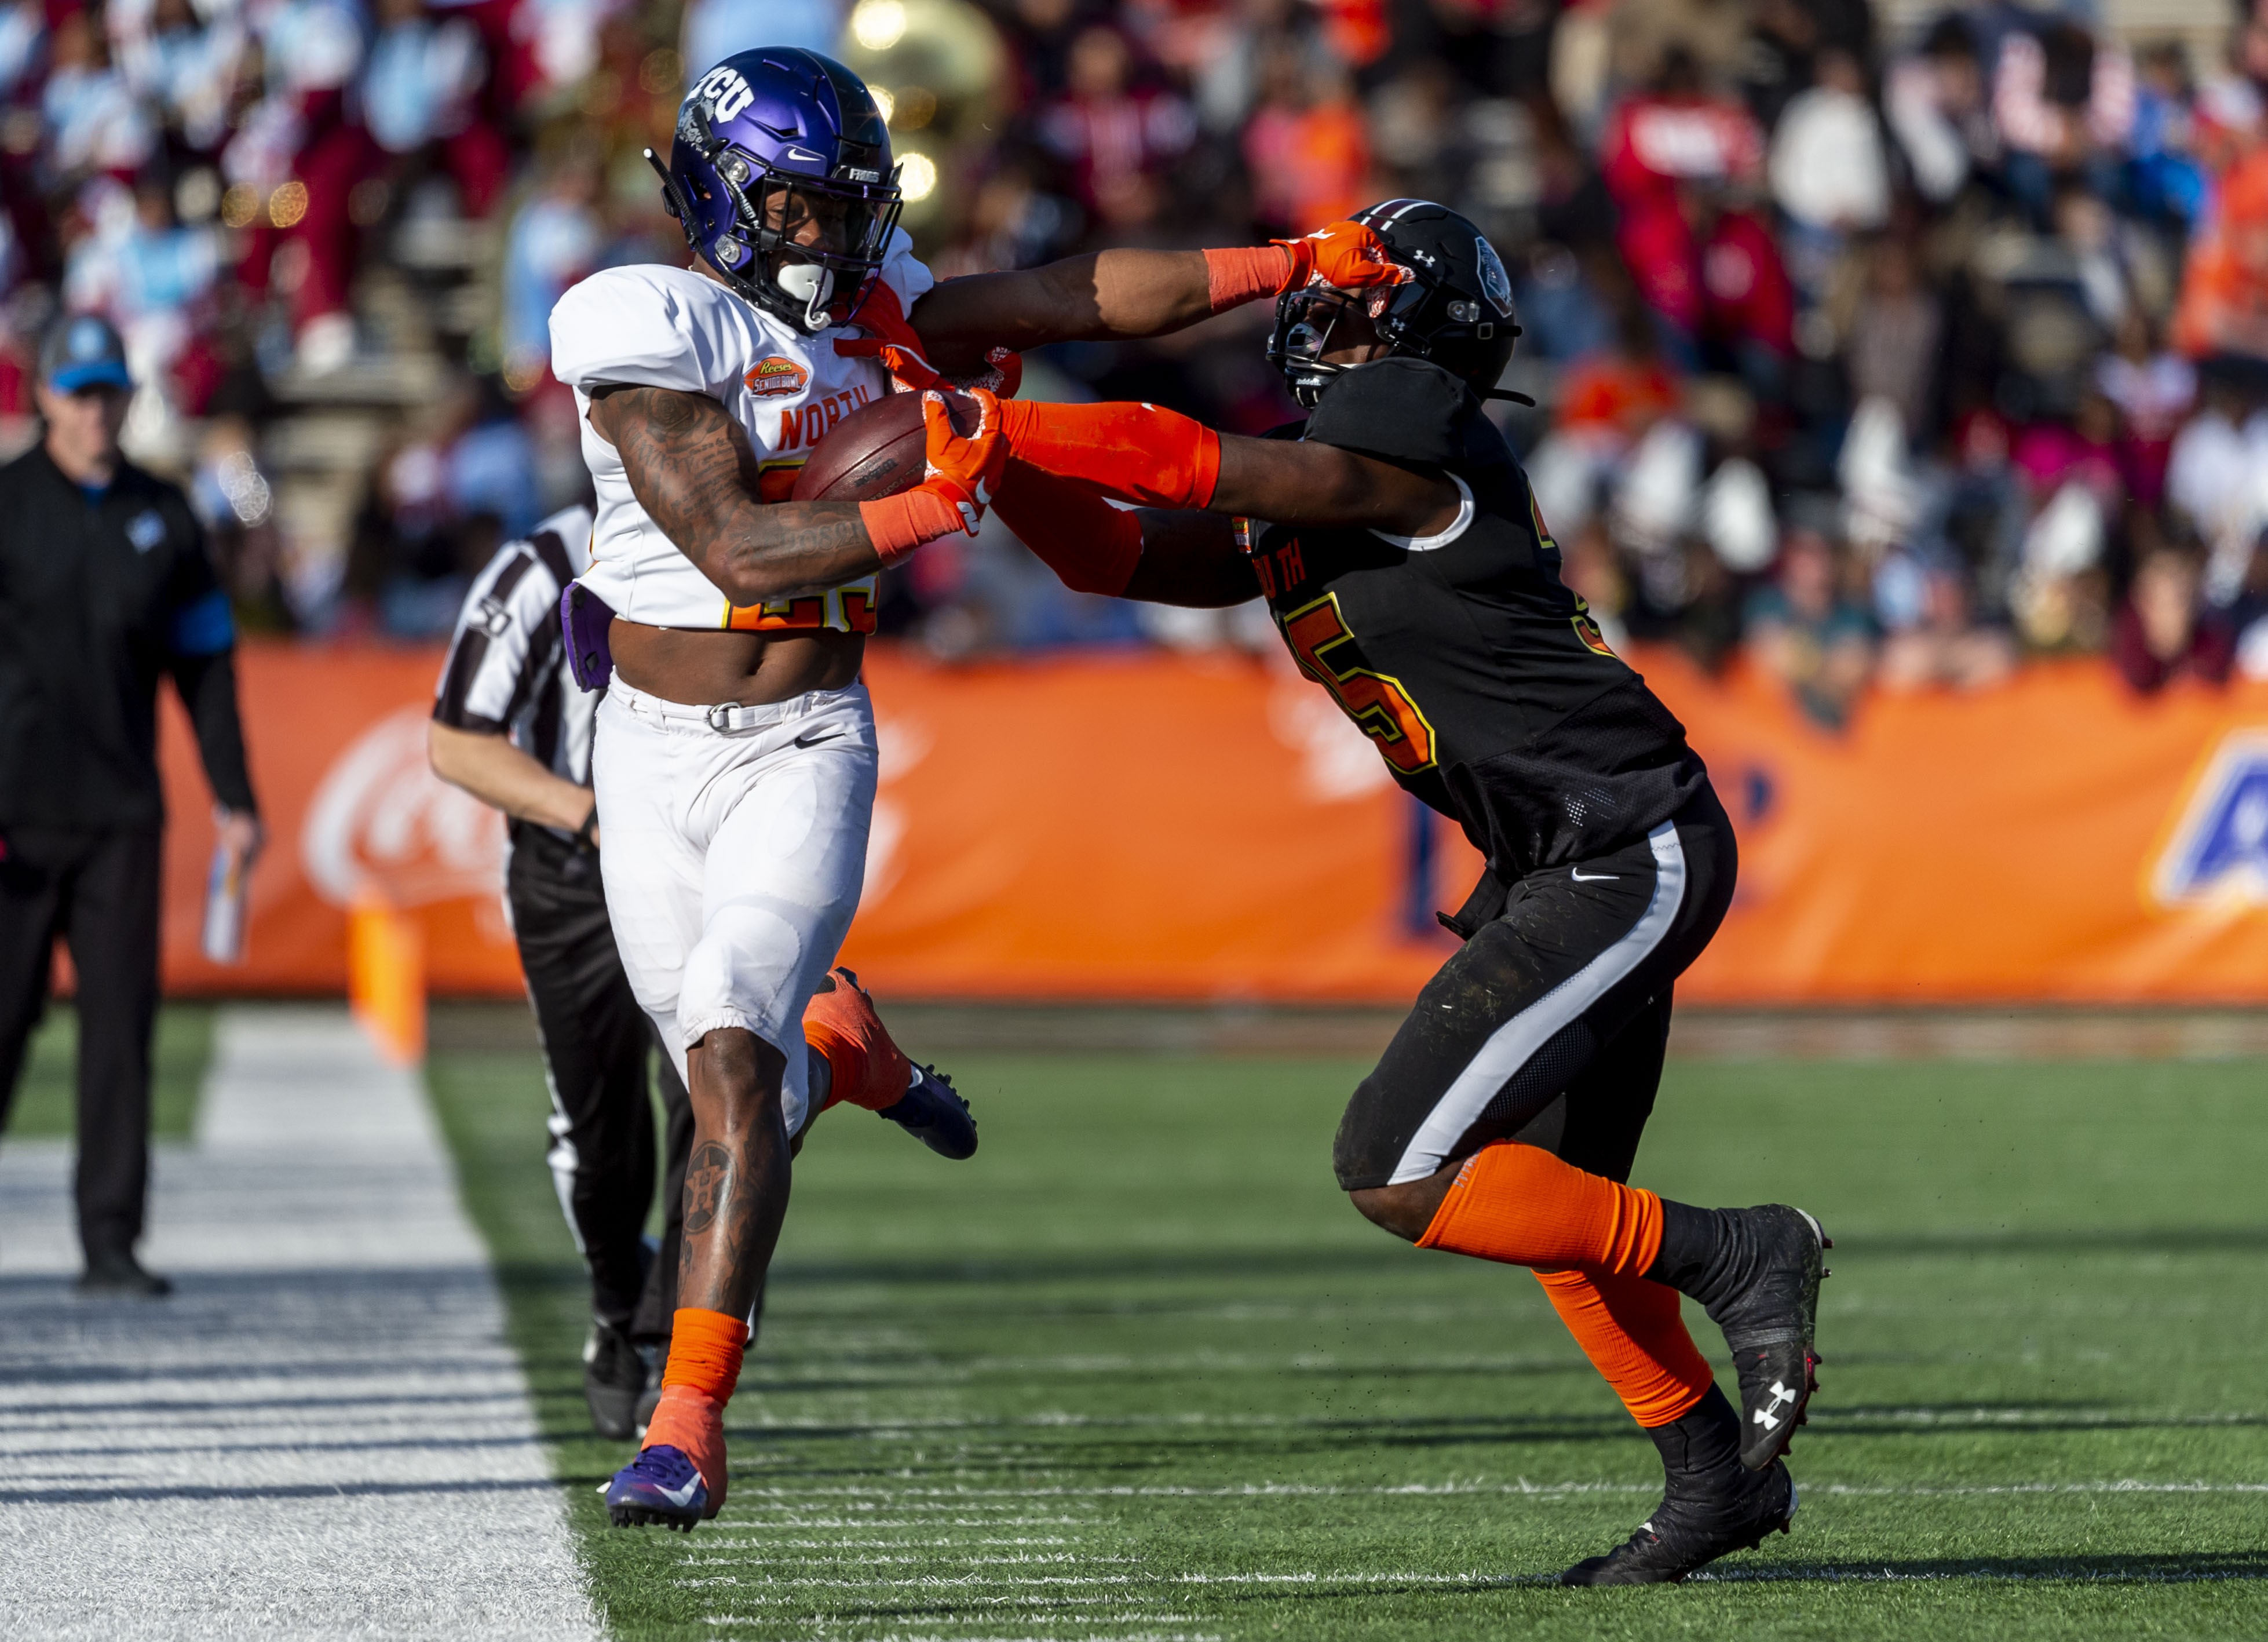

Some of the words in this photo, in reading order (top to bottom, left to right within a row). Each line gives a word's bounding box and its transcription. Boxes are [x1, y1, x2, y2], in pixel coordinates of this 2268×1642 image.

[685, 66, 755, 123] TCU
[754, 377, 780, 393] SENIOR
[780, 374, 801, 388] BOWL
[1252, 537, 1306, 601] UTH
